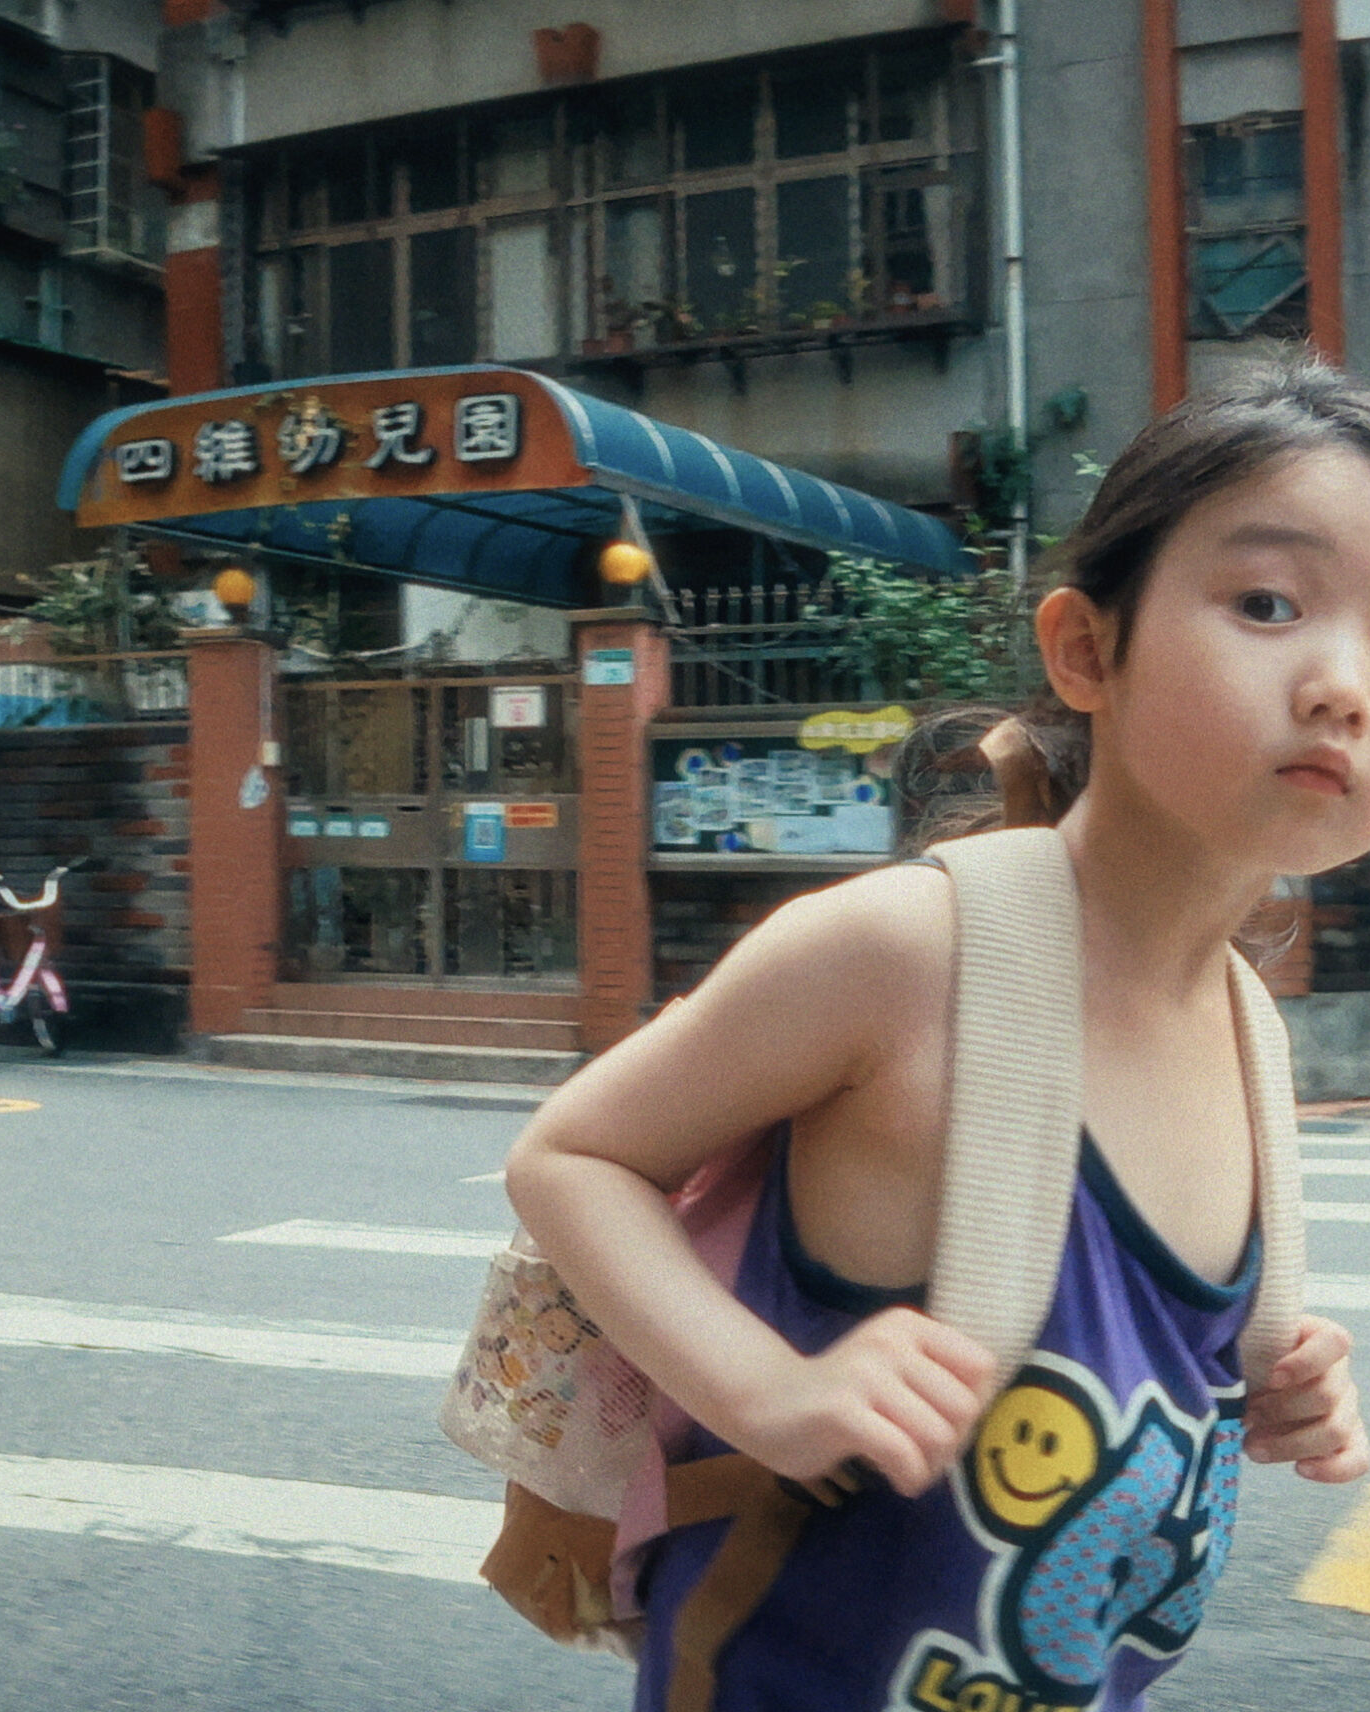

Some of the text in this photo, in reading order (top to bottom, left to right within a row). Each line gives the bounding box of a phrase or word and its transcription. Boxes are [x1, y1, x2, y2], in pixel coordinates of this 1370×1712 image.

[117, 392, 521, 484] 四維幼兒園
